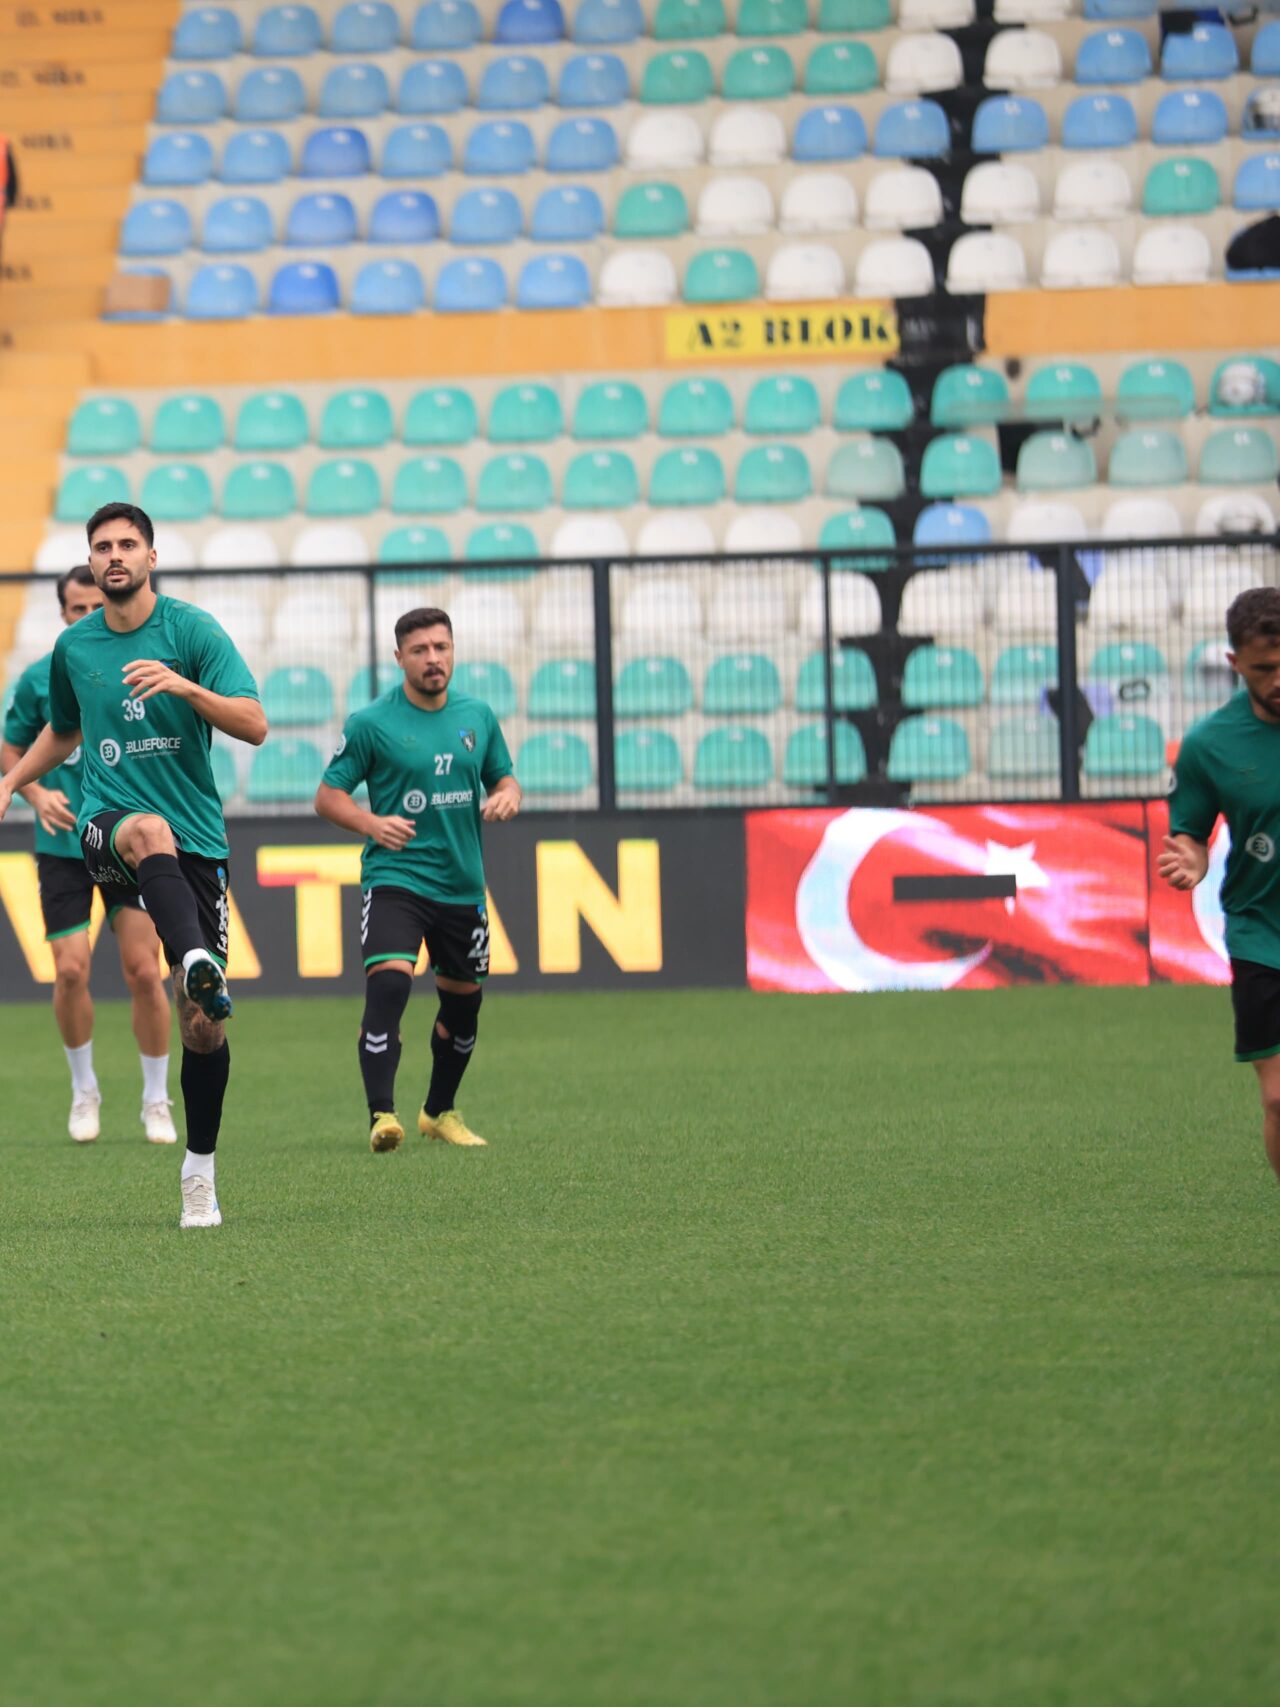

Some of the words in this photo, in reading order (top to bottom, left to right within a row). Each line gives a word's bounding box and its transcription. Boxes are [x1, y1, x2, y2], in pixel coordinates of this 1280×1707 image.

[688, 319, 743, 349] A2
[764, 311, 893, 347] BLOK
[121, 697, 146, 722] 39
[125, 737, 182, 755] BLUEFORCE
[434, 752, 454, 776] 27
